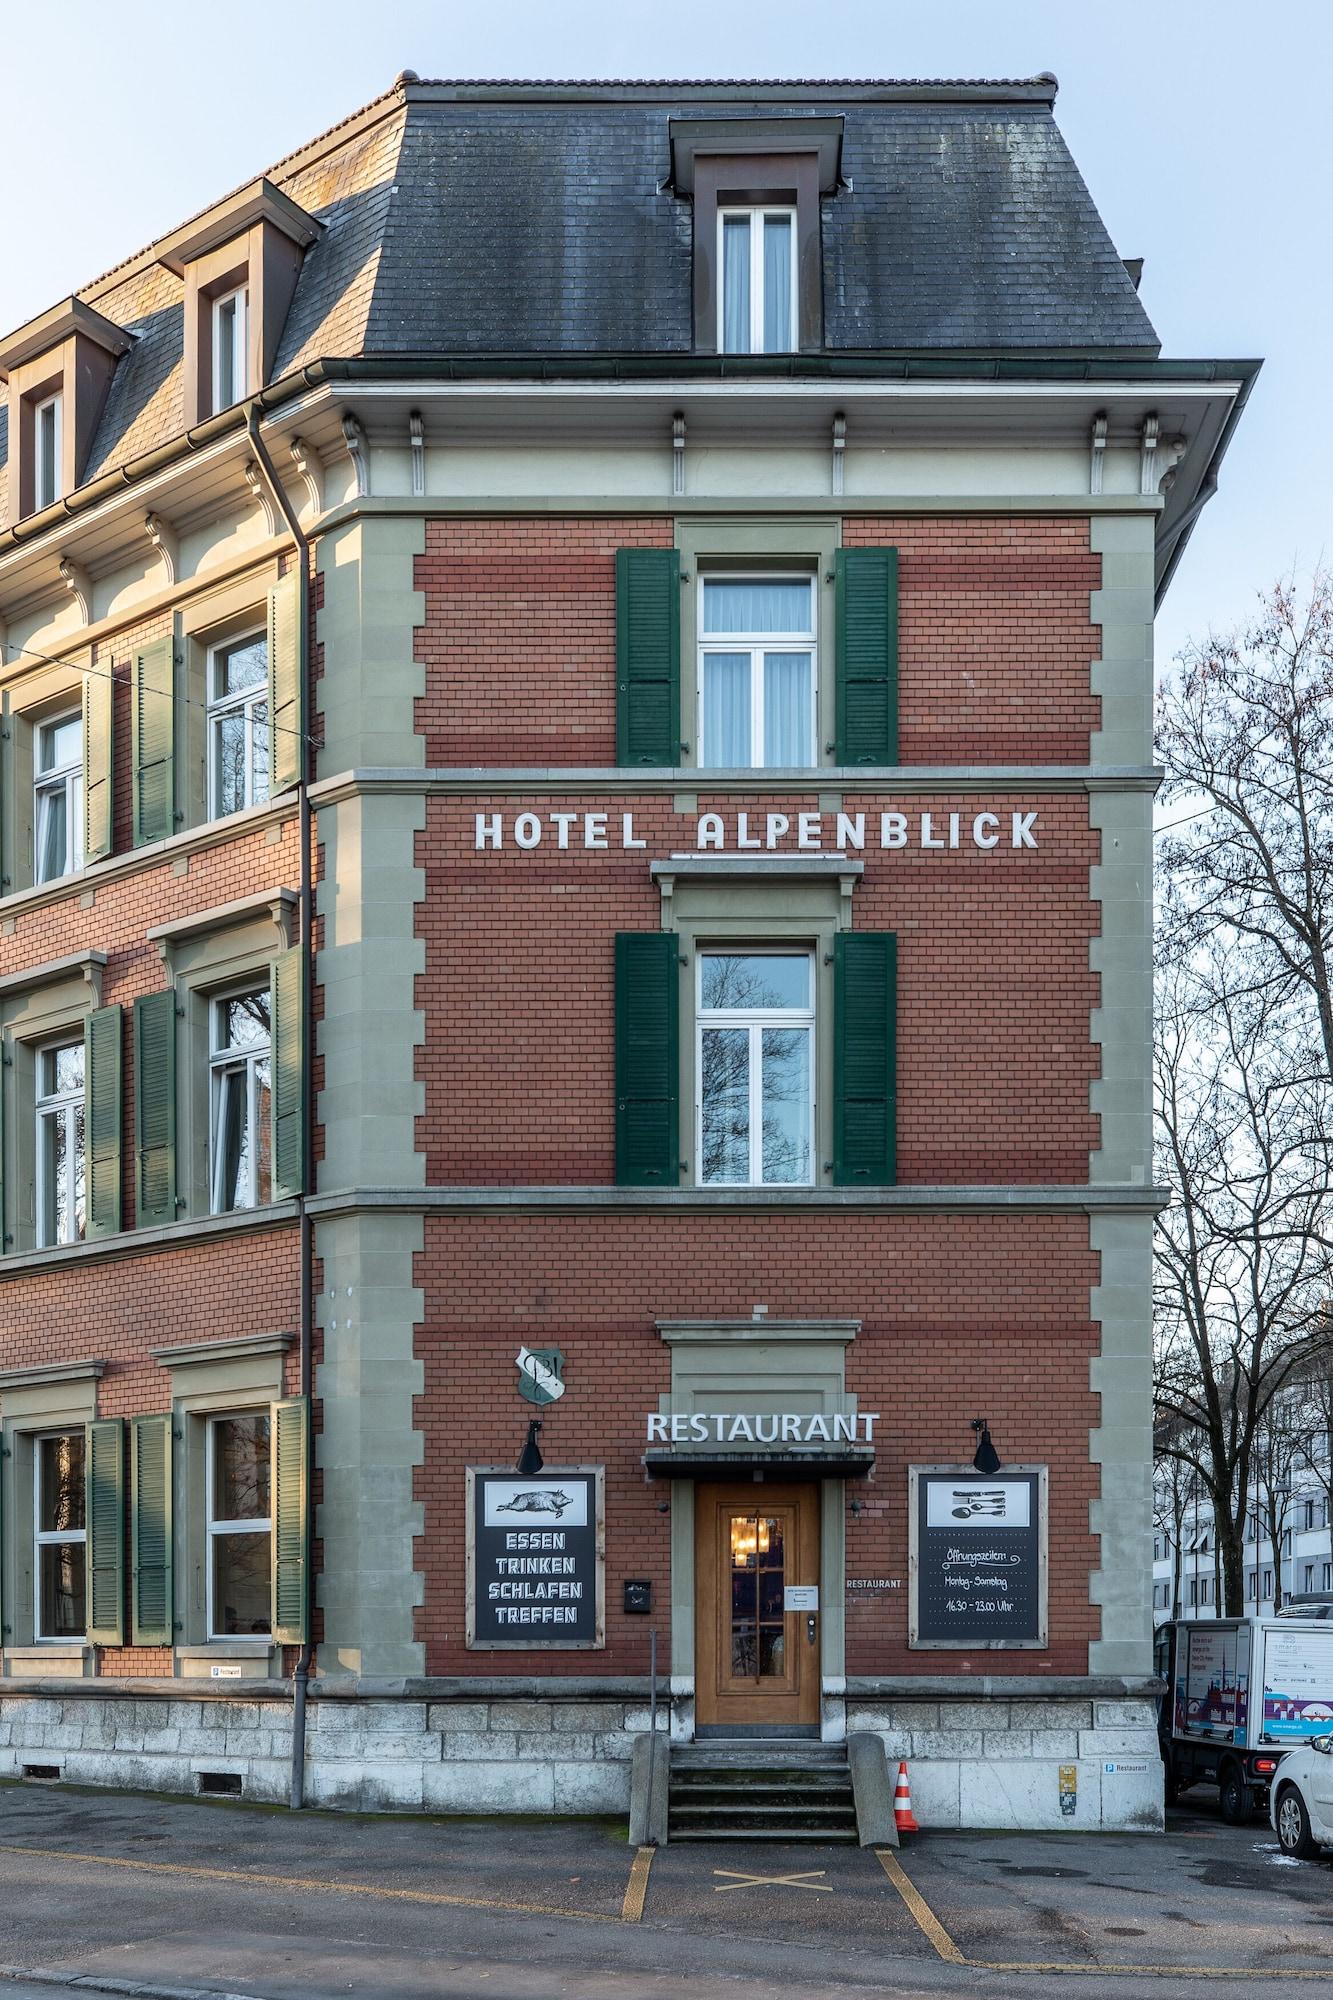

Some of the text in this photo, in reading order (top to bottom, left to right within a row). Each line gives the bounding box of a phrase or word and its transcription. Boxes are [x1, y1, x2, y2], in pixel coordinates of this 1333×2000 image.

[475, 812, 1039, 850] HOTEL ALPENBLICK
[647, 1413, 881, 1442] RESTAURANT
[506, 1532, 566, 1550] ESSEN
[495, 1557, 576, 1575] TRINKEN
[946, 1548, 1007, 1568] Öffnungszeiten:
[488, 1582, 583, 1600] SCHLAFEN
[846, 1579, 902, 1589] RESTAURANT
[495, 1606, 578, 1624] TREFFEN
[997, 1600, 1014, 1612] Uhr
[1116, 1764, 1147, 1772] Restaurant
